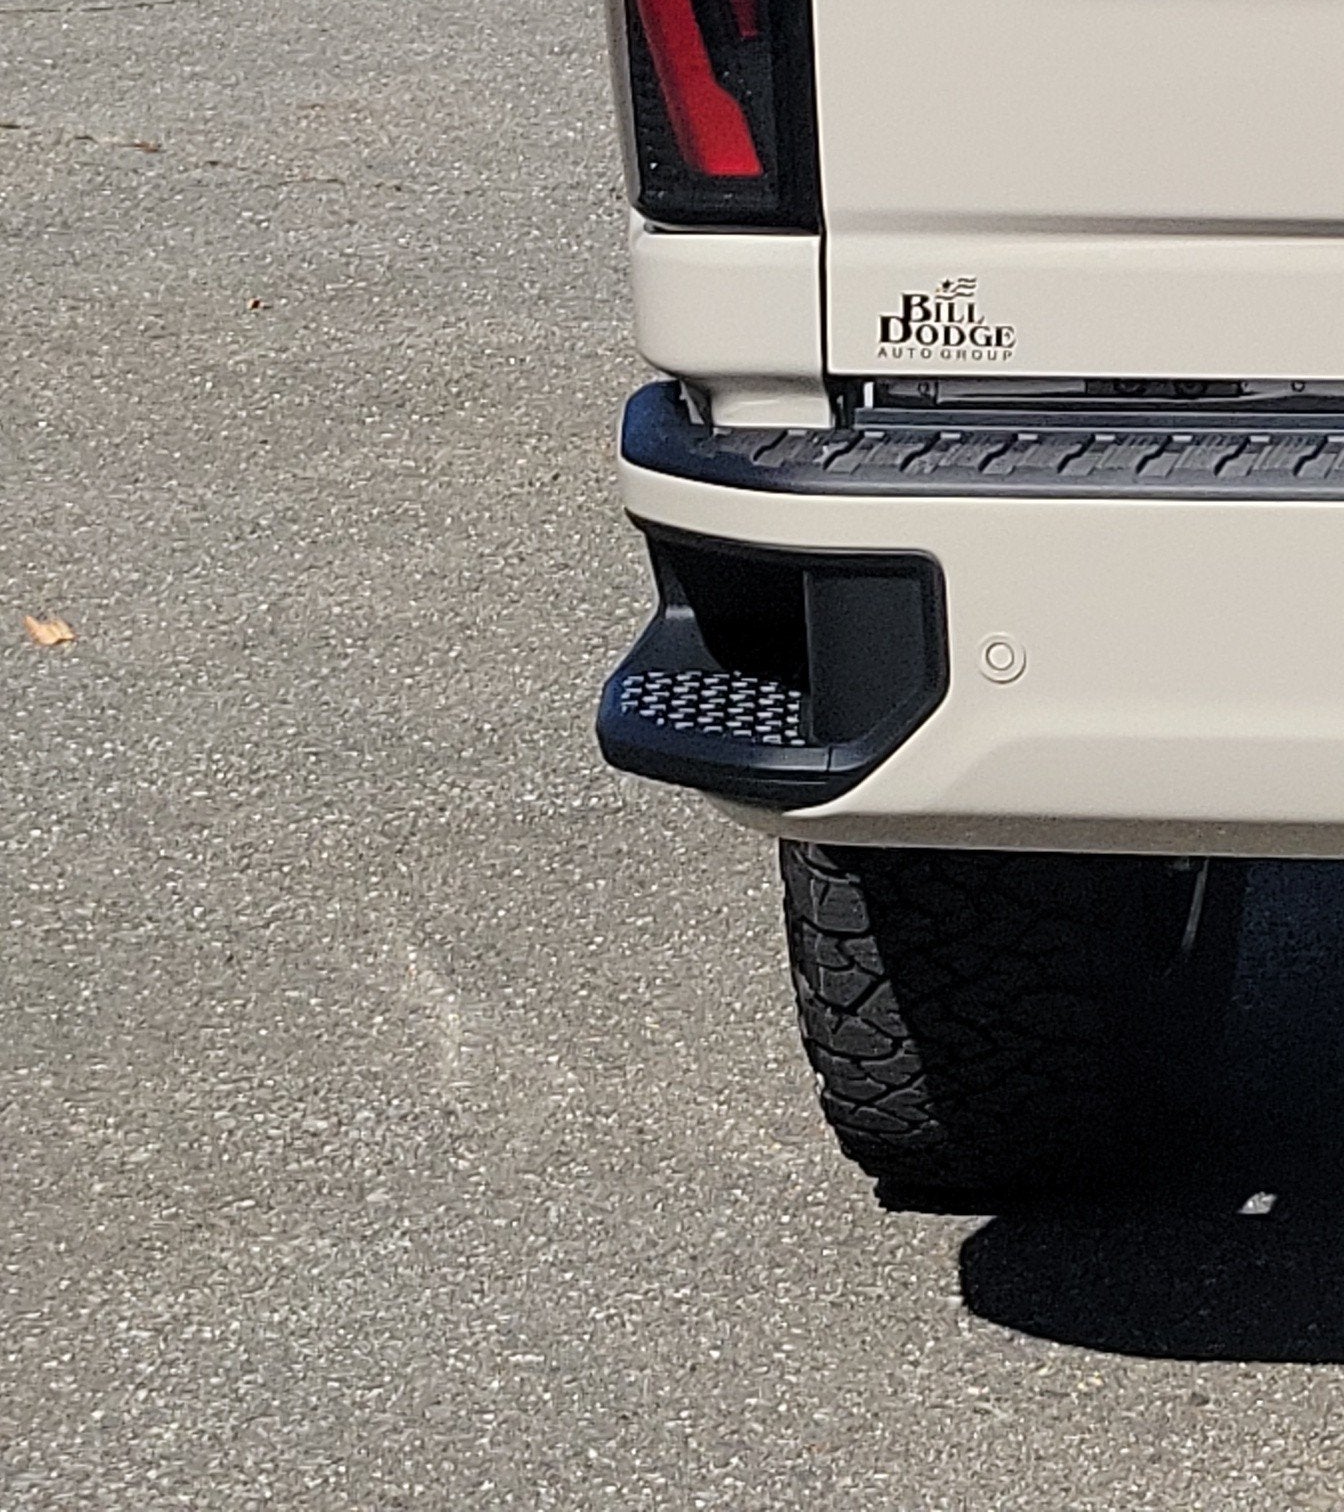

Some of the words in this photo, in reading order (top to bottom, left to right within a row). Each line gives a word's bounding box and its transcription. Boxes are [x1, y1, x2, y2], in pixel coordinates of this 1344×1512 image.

[902, 293, 985, 324] BILL
[879, 315, 1016, 348] DODGE
[877, 347, 933, 359] AUTO
[939, 348, 1013, 361] GROUP
